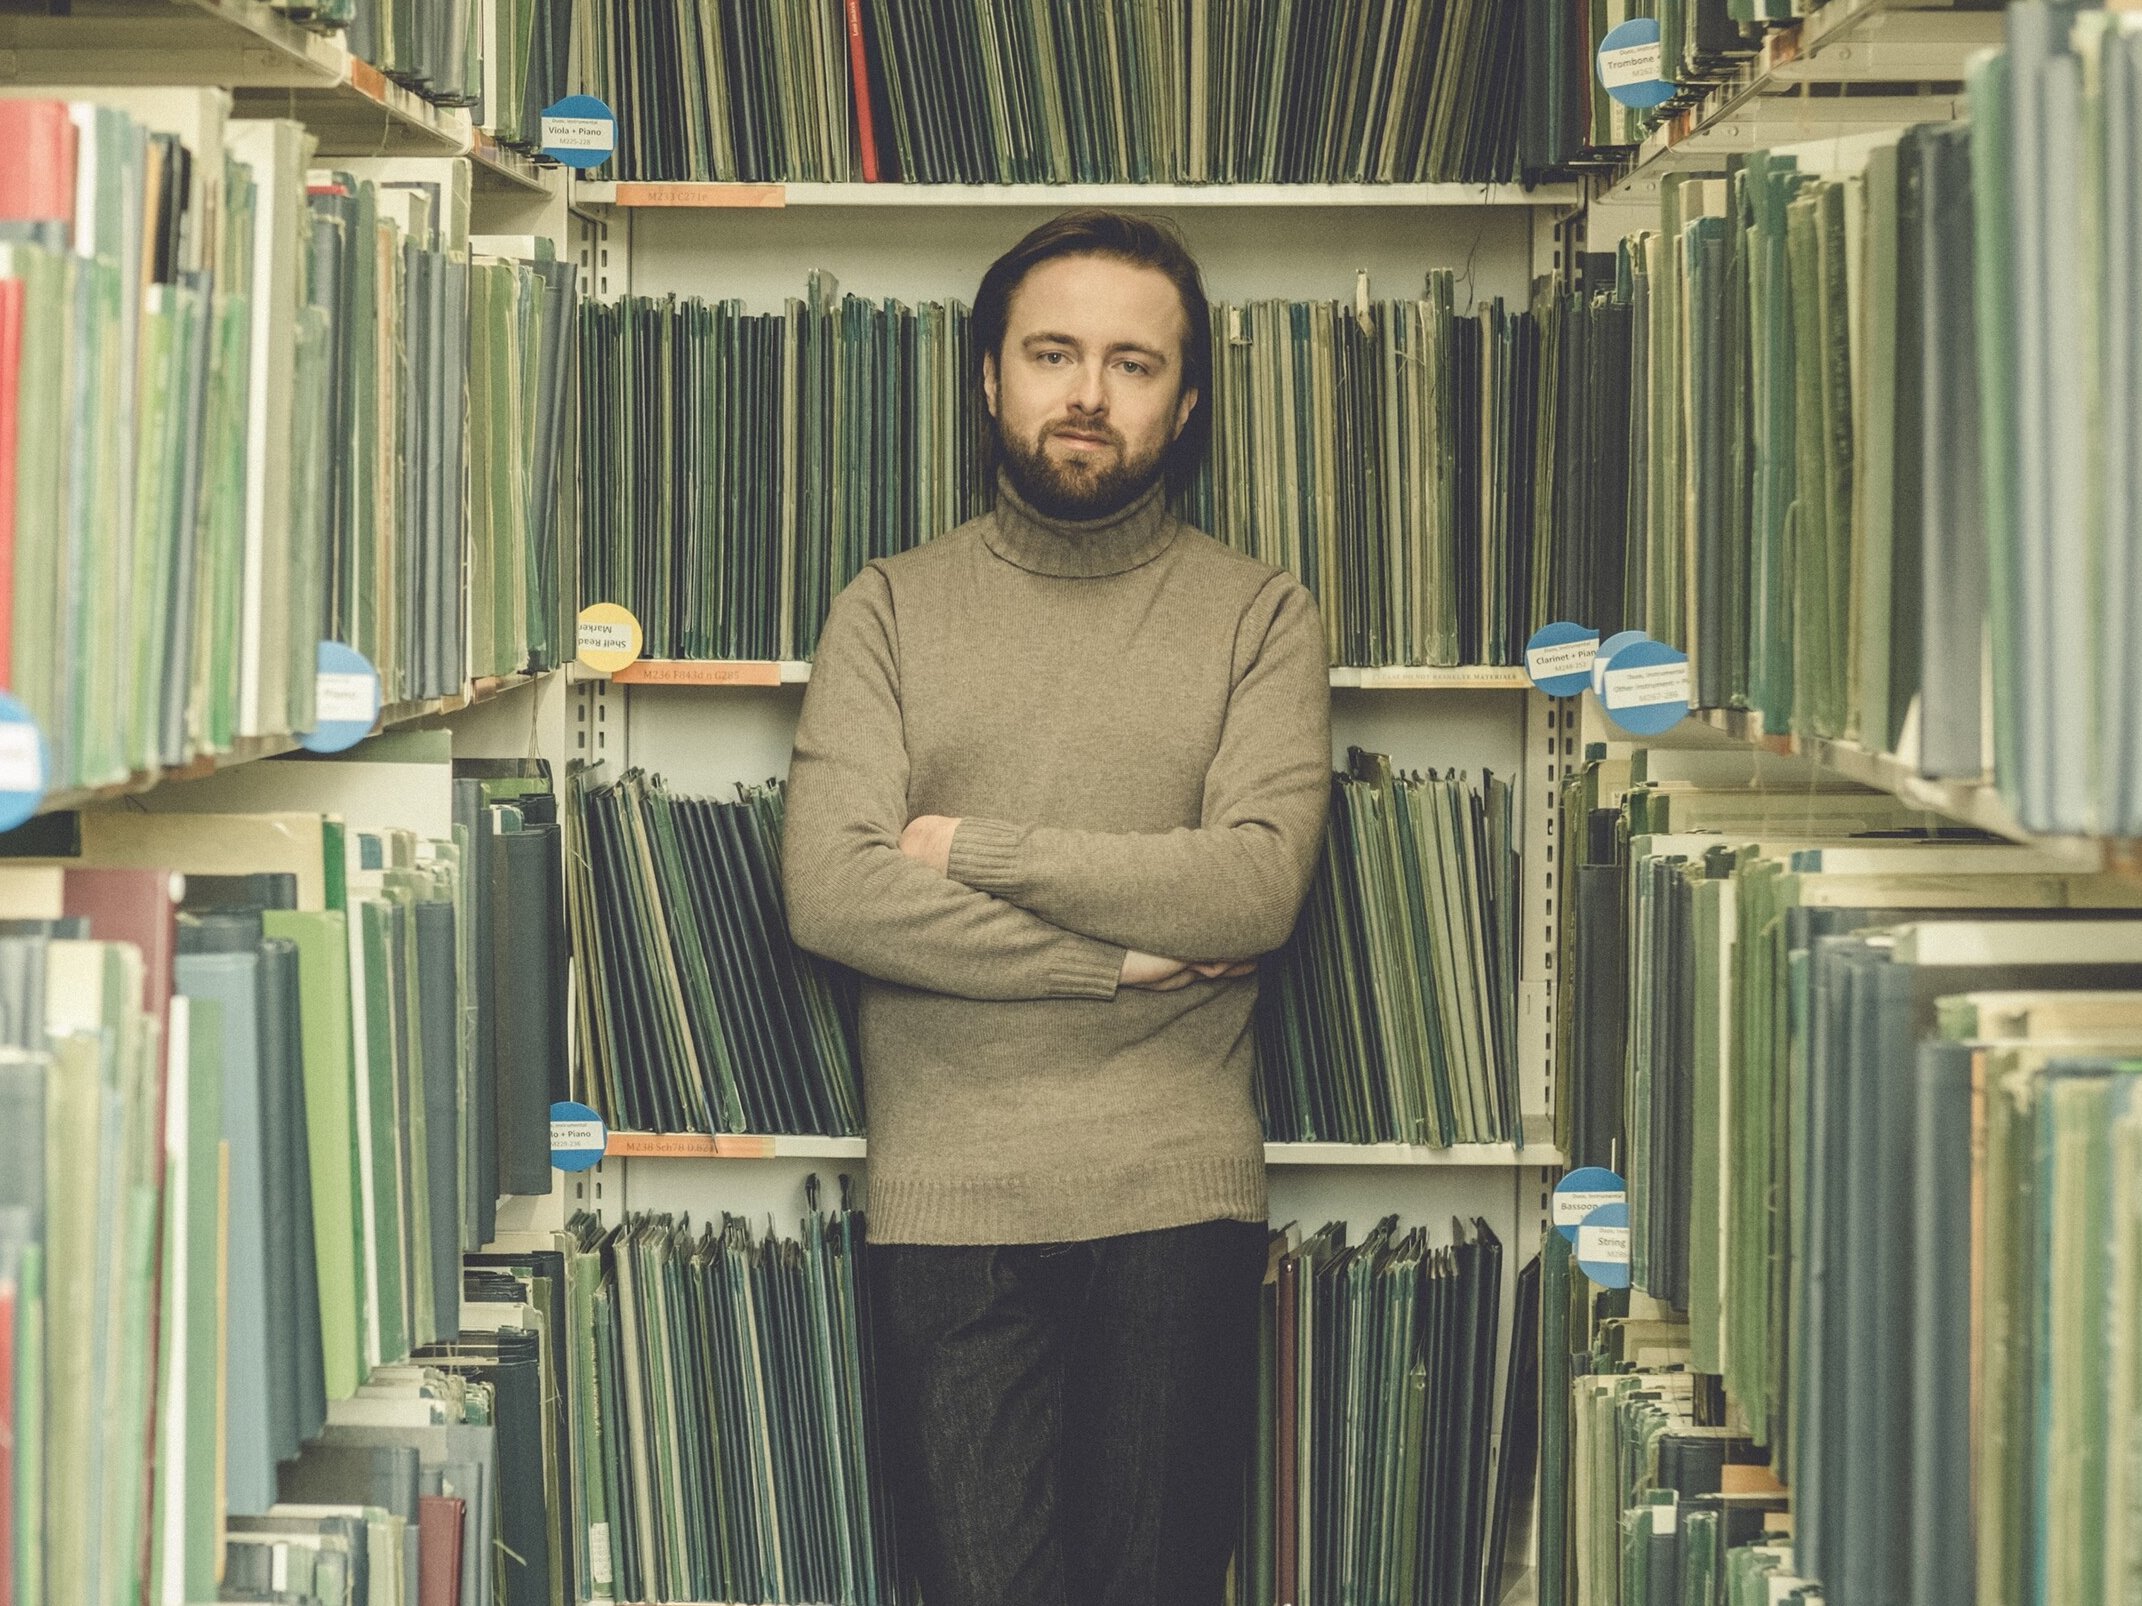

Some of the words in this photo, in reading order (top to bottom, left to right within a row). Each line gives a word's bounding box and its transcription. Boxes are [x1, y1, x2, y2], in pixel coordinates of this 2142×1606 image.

[1608, 56, 1654, 70] Trombone
[549, 127, 570, 135] Viola
[578, 128, 602, 136] Piano
[579, 624, 612, 634] Marker
[604, 640, 626, 648] Shelf
[1536, 653, 1569, 665] Clarinet
[1578, 650, 1597, 658] Pian
[643, 669, 671, 679] M236
[567, 1130, 592, 1138] Piano
[626, 1142, 654, 1151] M238
[656, 1142, 685, 1152] Sch78
[1561, 1202, 1599, 1211] Bassoon
[1598, 1237, 1626, 1249] String
